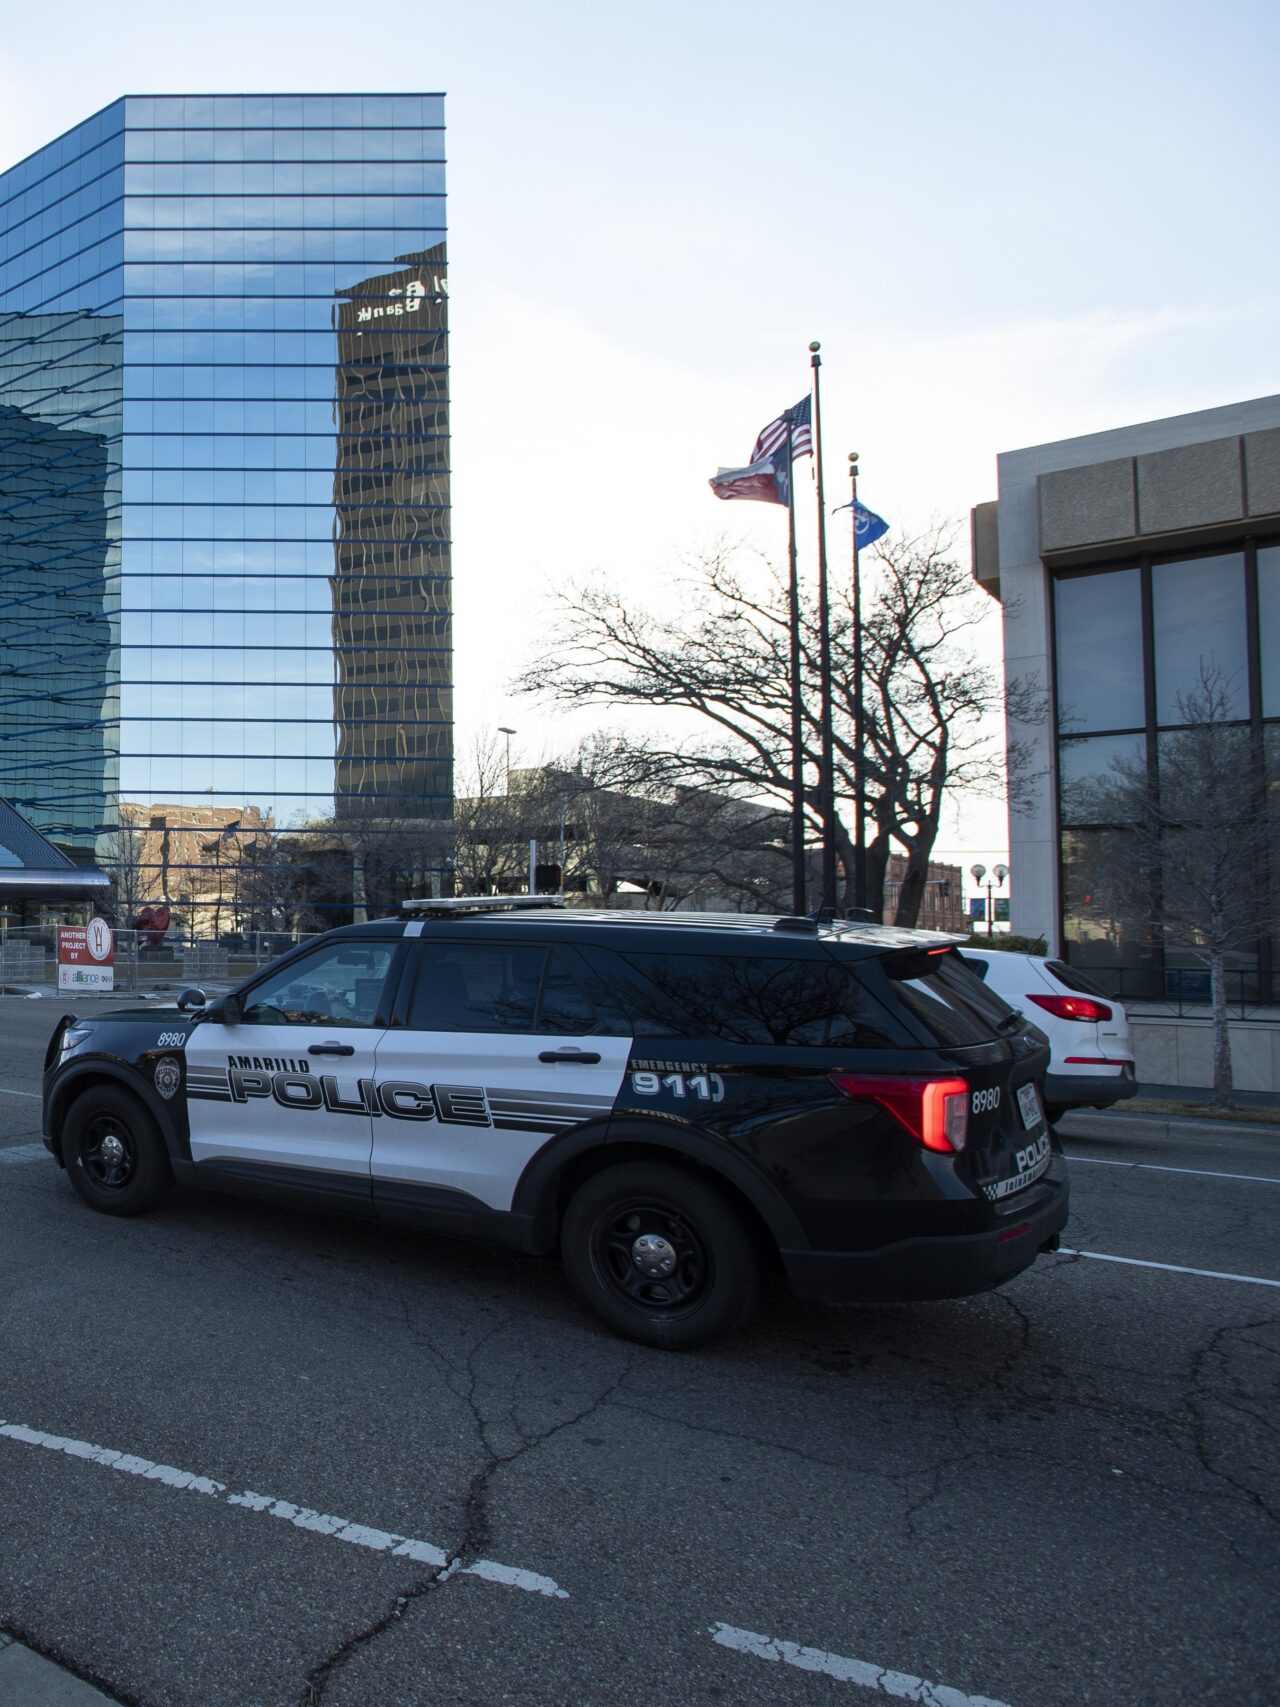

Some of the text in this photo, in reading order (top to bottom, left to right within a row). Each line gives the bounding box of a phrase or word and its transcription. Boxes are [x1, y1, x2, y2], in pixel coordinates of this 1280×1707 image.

[61, 931, 86, 939] ANOTHER
[62, 941, 86, 949] PROJECT
[72, 971, 99, 983] alliance
[157, 1032, 186, 1047] 8980
[228, 1055, 310, 1073] AMARILLO
[631, 1059, 708, 1073] EMERGENCY
[632, 1072, 712, 1100] 911
[228, 1069, 491, 1128] POLICE
[972, 1086, 1000, 1114] 8980
